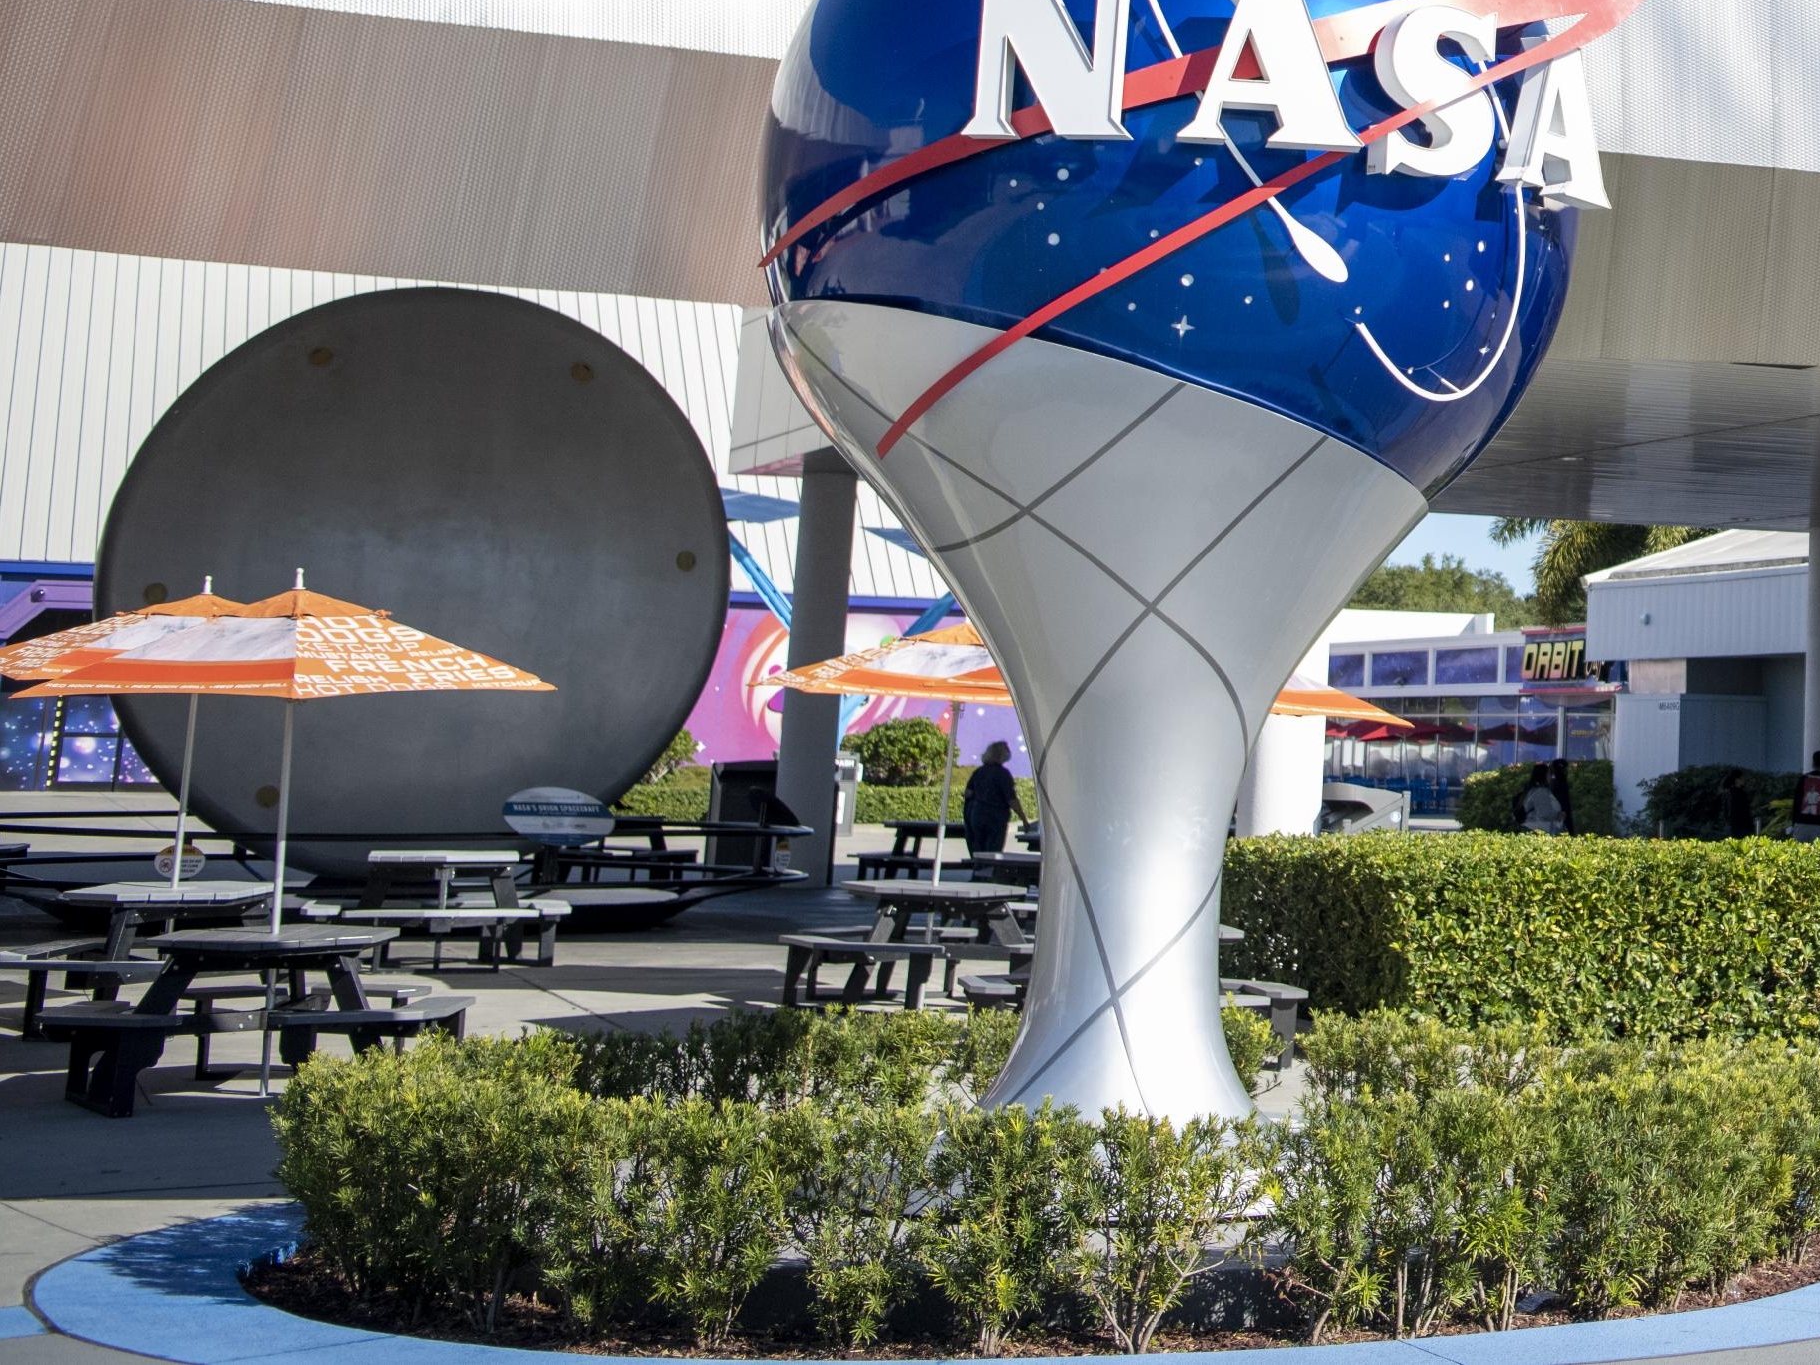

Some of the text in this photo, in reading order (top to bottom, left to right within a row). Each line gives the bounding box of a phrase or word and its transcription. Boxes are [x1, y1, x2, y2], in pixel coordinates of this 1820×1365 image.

[297, 615, 383, 629] HOT
[295, 626, 426, 643] DOGS
[296, 642, 420, 653] KETCHUP
[408, 647, 465, 658] RELISH
[296, 651, 390, 661] MUSTARD
[1521, 639, 1585, 680] ORBIT
[324, 654, 489, 673] FRENCH
[294, 674, 390, 684] RELISH
[406, 665, 517, 683] FRIES
[293, 682, 459, 696] HOT DOGS
[471, 678, 543, 689] KETCHUP
